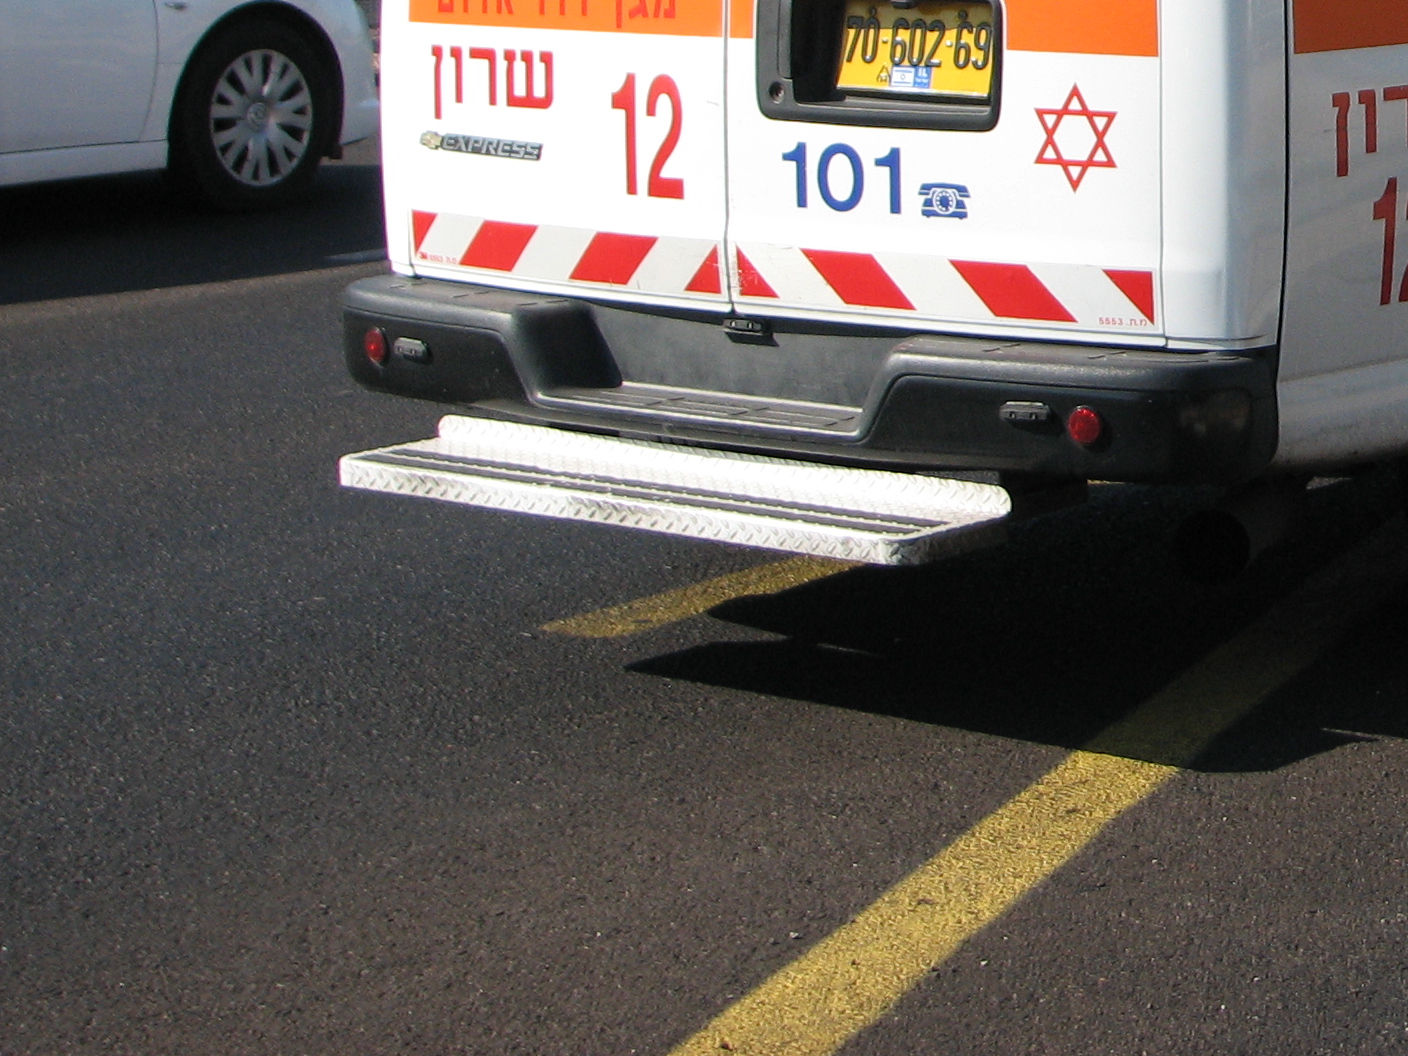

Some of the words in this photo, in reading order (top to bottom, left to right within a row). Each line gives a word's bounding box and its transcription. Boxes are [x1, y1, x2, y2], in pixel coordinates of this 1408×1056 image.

[431, 44, 554, 120] שרון
[441, 134, 540, 160] EXPRESS
[611, 73, 685, 200] 12
[781, 142, 902, 215] 101
[1098, 316, 1124, 326] 5553
